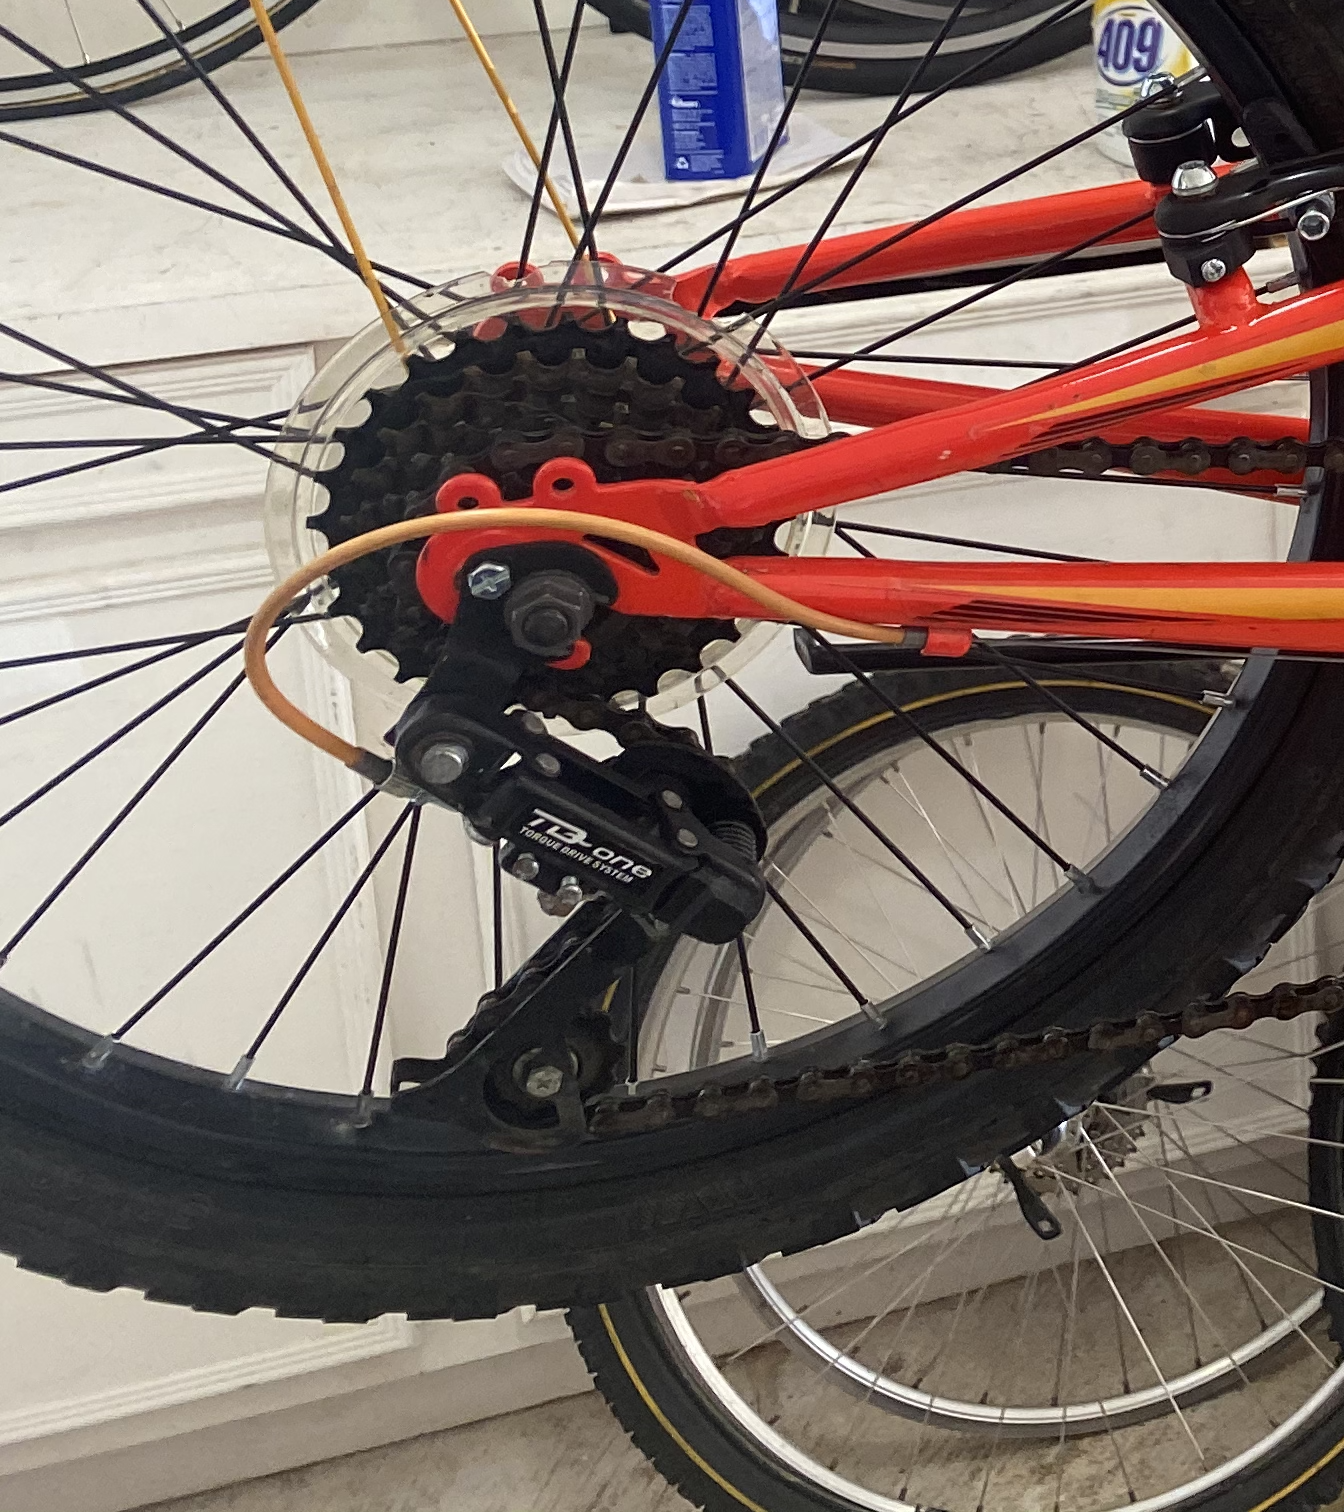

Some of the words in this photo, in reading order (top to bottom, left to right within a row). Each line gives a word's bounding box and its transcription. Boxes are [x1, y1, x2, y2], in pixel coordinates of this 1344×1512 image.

[1098, 17, 1163, 73] 409
[519, 825, 562, 851] TORQUE
[561, 843, 594, 865] DRIVE
[591, 860, 634, 883] SYSTEM
